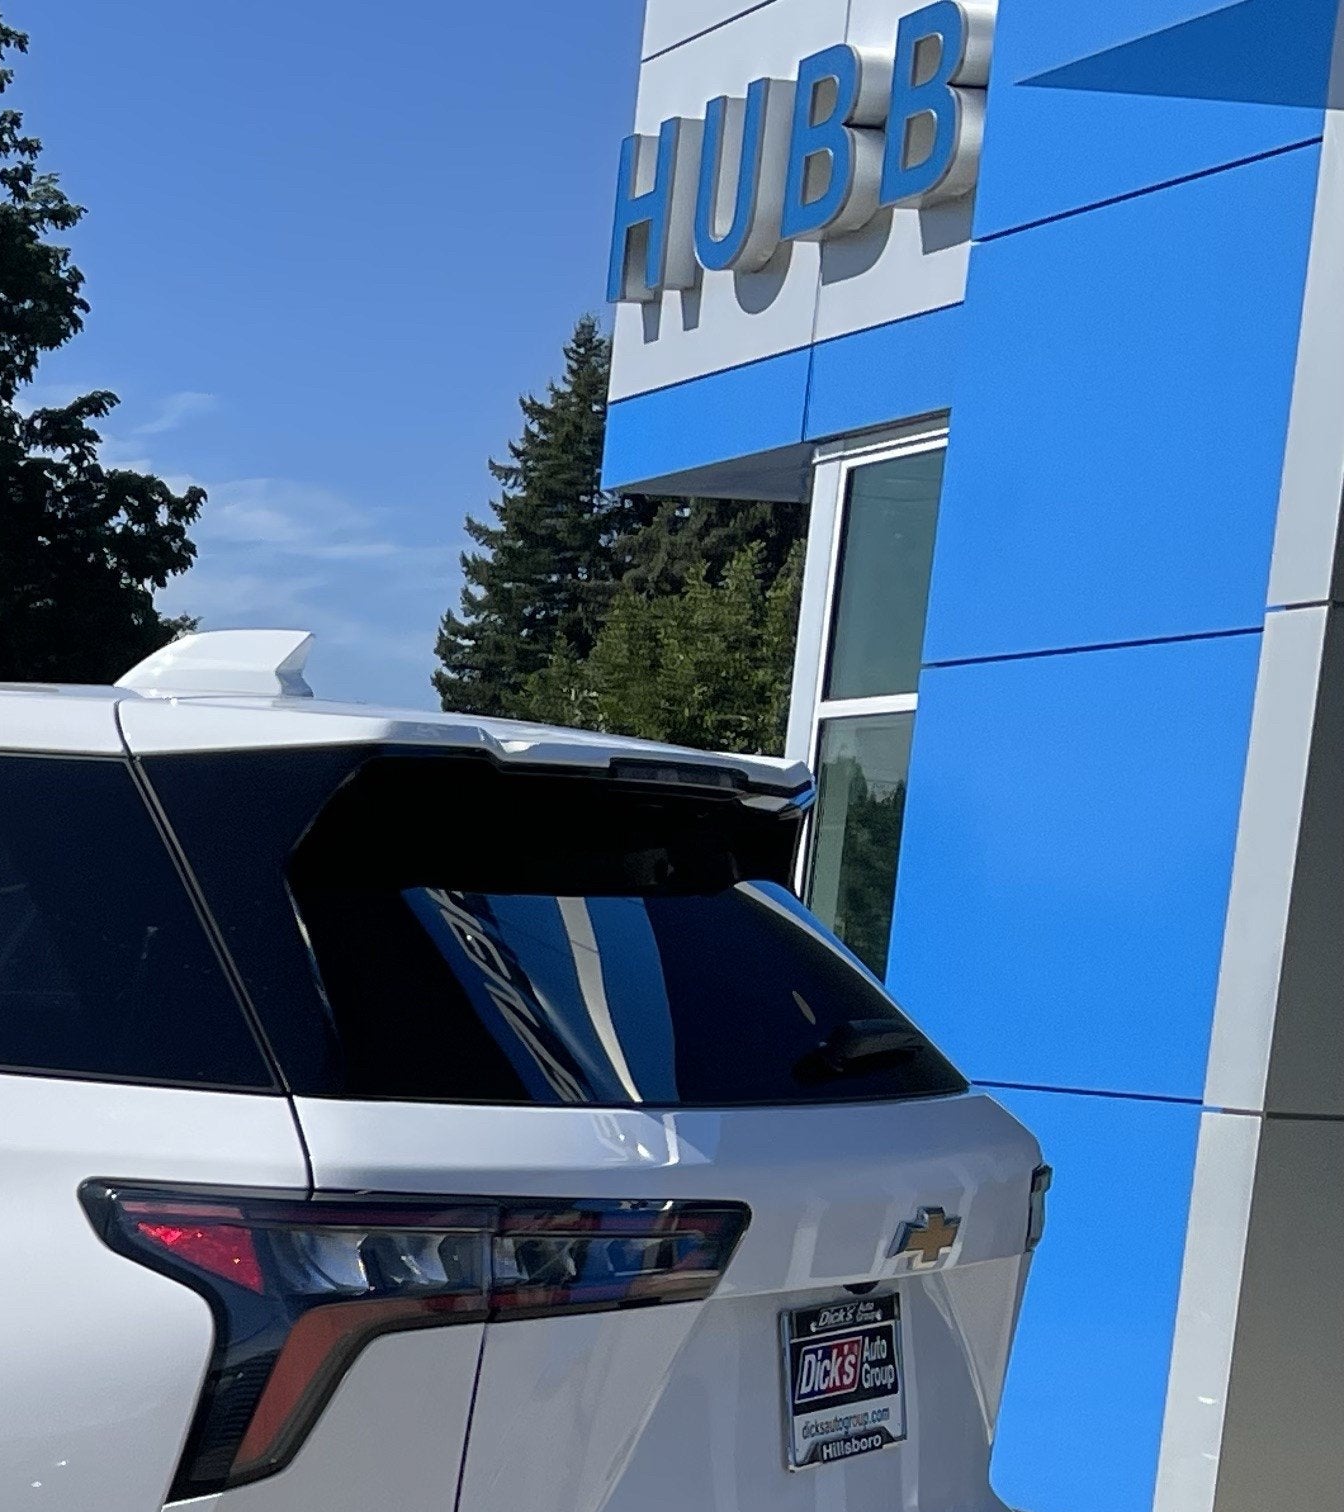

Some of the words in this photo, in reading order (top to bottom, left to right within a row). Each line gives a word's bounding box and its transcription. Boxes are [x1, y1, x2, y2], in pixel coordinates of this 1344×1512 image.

[606, 0, 970, 303] HUBB
[863, 1336, 887, 1362] Auto
[800, 1343, 858, 1394] Dick's
[862, 1363, 895, 1390] Group
[802, 1407, 891, 1440] dicksautogroup.com
[822, 1434, 882, 1460] Hillsboro
